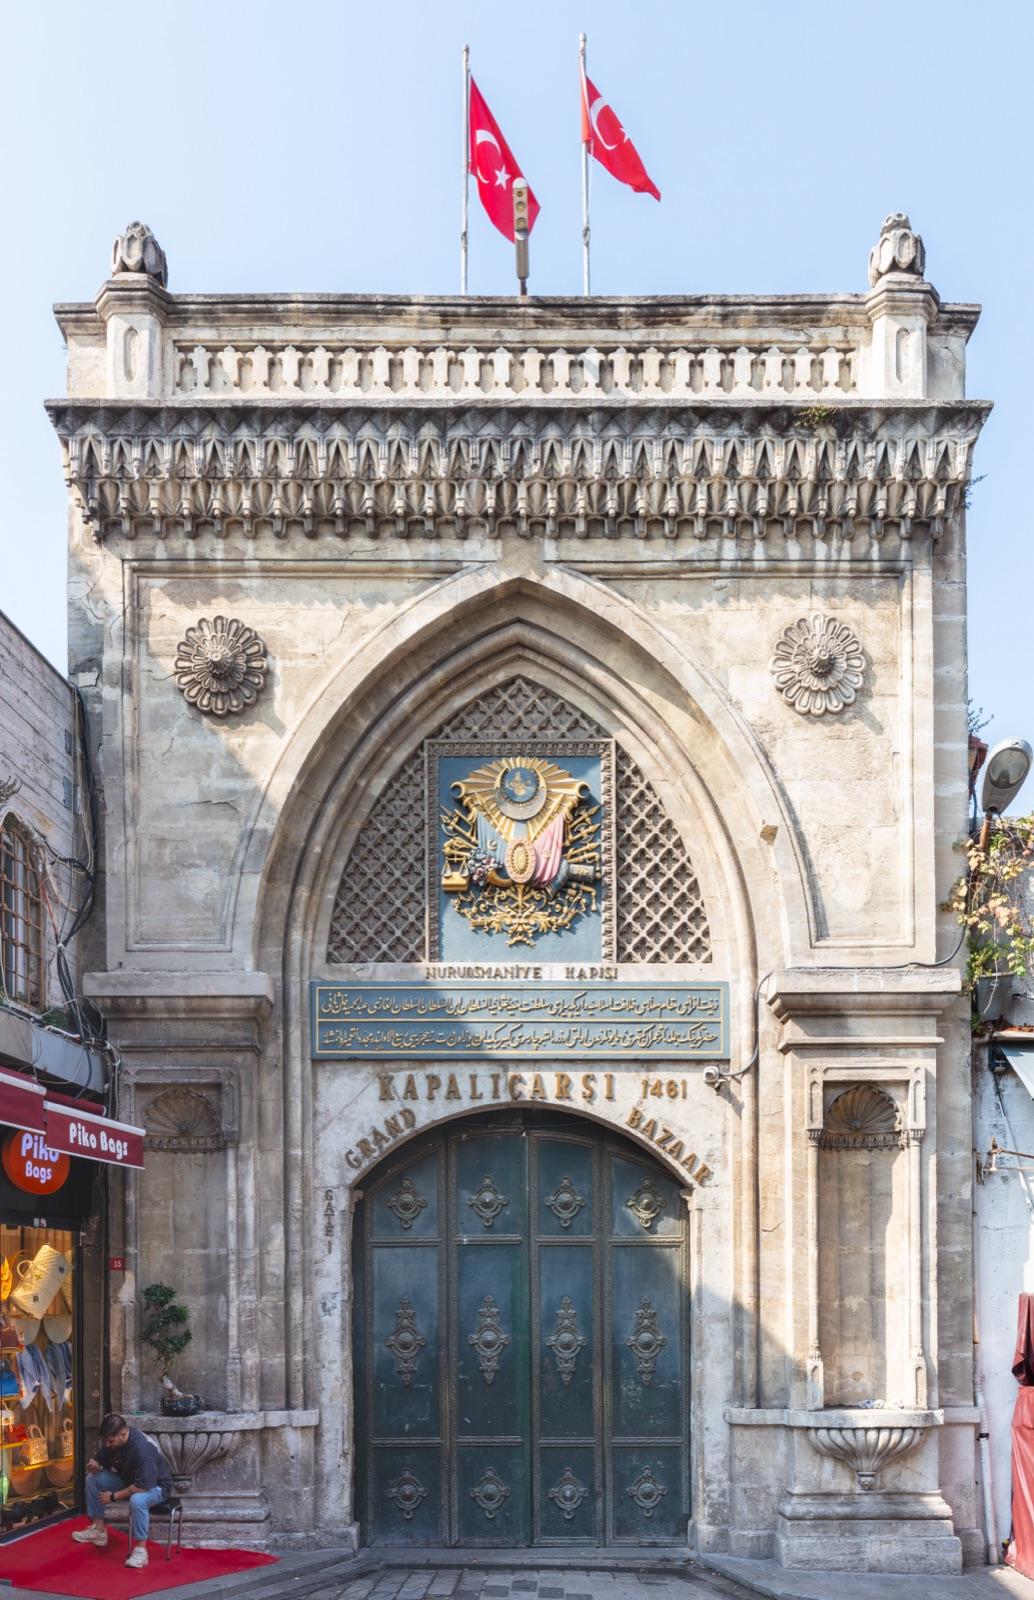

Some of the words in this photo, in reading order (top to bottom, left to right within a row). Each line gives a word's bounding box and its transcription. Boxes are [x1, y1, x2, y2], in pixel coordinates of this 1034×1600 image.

[69, 1122, 97, 1149] Piko
[100, 1131, 128, 1160] Bags
[345, 1107, 416, 1169] GRAND
[625, 1107, 712, 1186] BAZAAR
[25, 1161, 52, 1184] Bags
[324, 1189, 335, 1237] GATE
